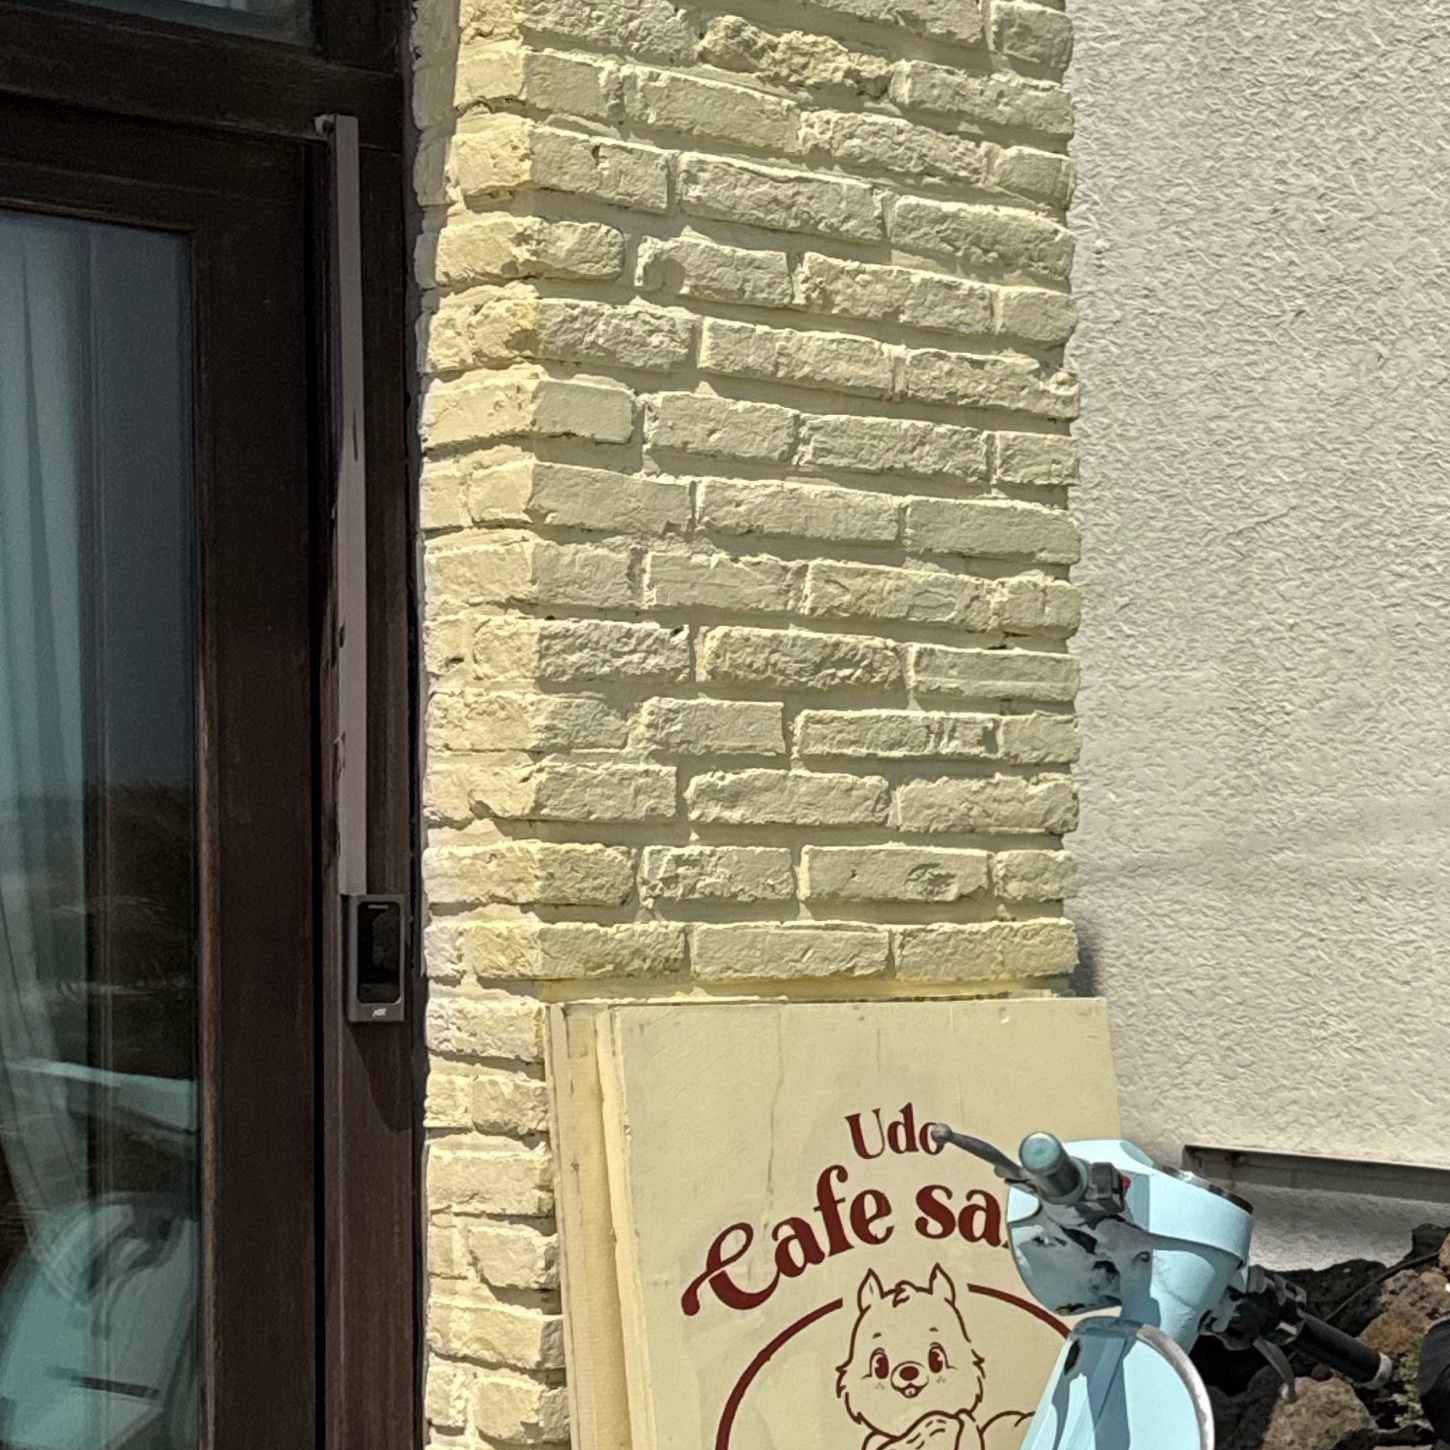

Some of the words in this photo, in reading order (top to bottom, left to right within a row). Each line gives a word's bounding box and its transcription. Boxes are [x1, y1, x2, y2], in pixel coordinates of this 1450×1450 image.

[844, 1102, 947, 1159] Udo
[681, 1164, 895, 1316] Cafe
[915, 1184, 1010, 1248] sa
